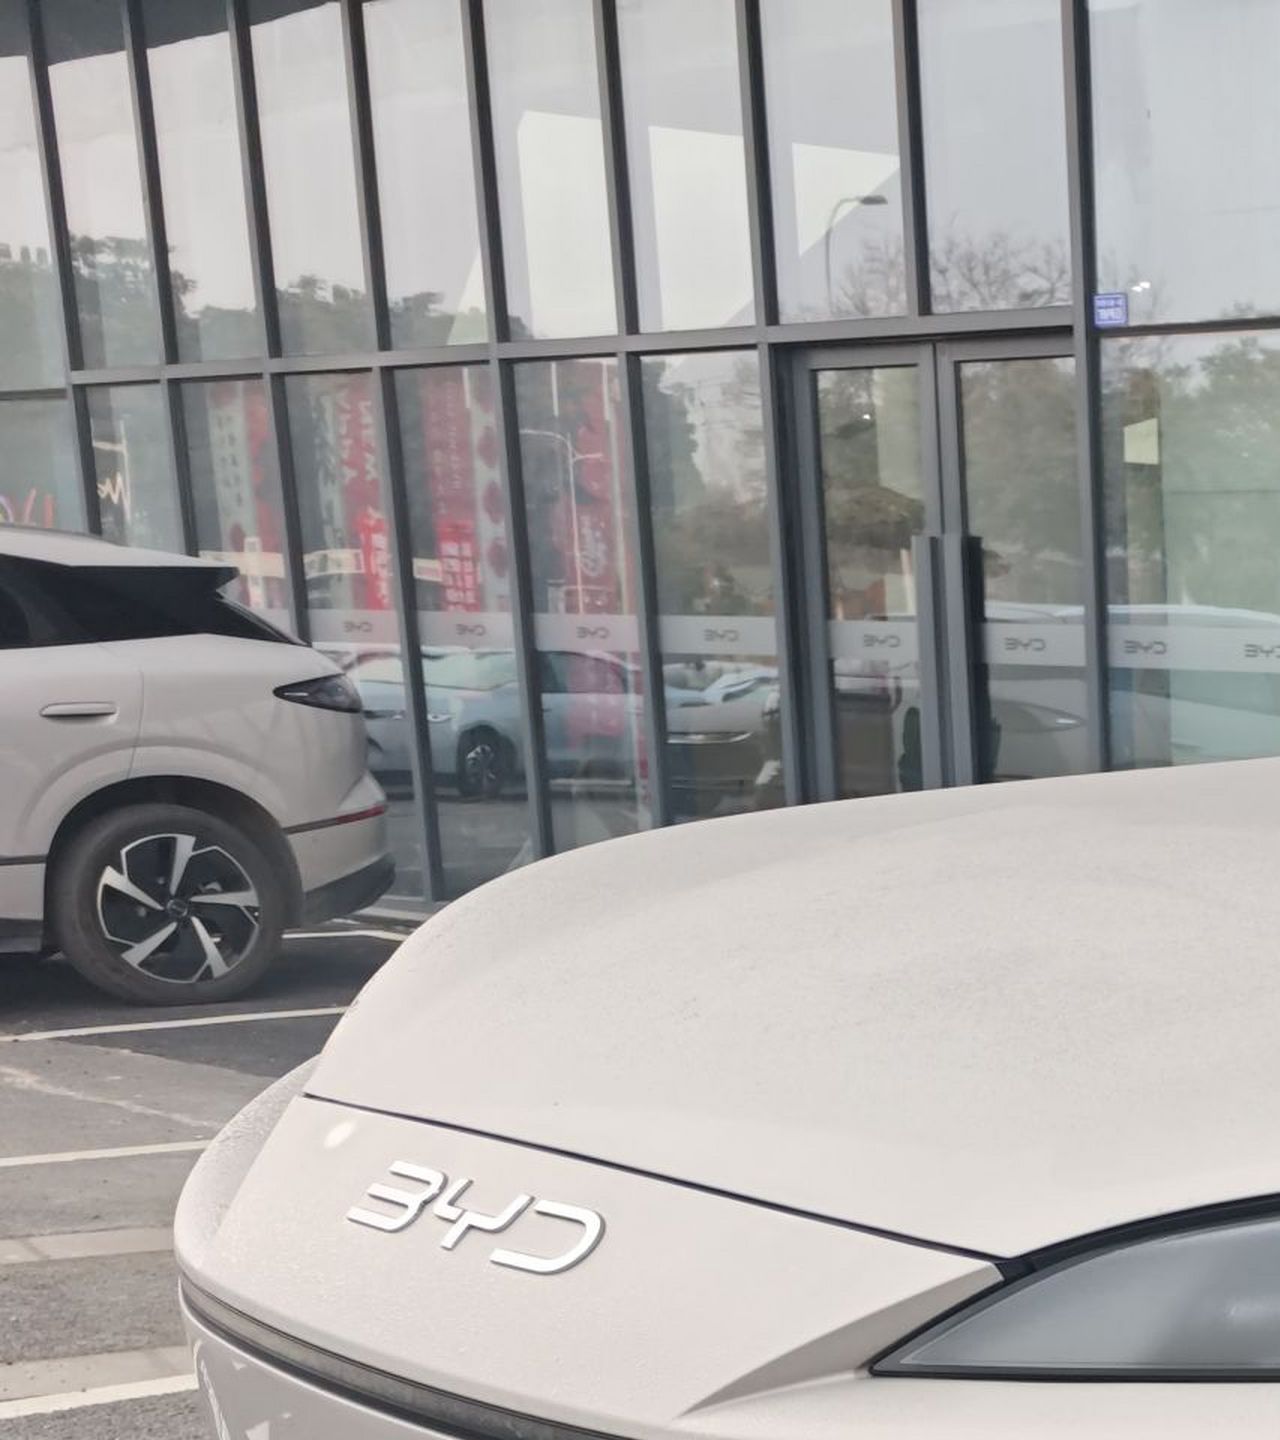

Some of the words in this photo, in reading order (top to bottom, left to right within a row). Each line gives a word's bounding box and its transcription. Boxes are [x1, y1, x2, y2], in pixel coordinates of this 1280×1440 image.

[576, 626, 610, 639] BYD
[704, 629, 740, 642] BYD
[863, 634, 901, 648] BYD
[1005, 637, 1047, 651] BYD
[1123, 640, 1167, 654] BYD
[346, 1160, 606, 1275] BYD
